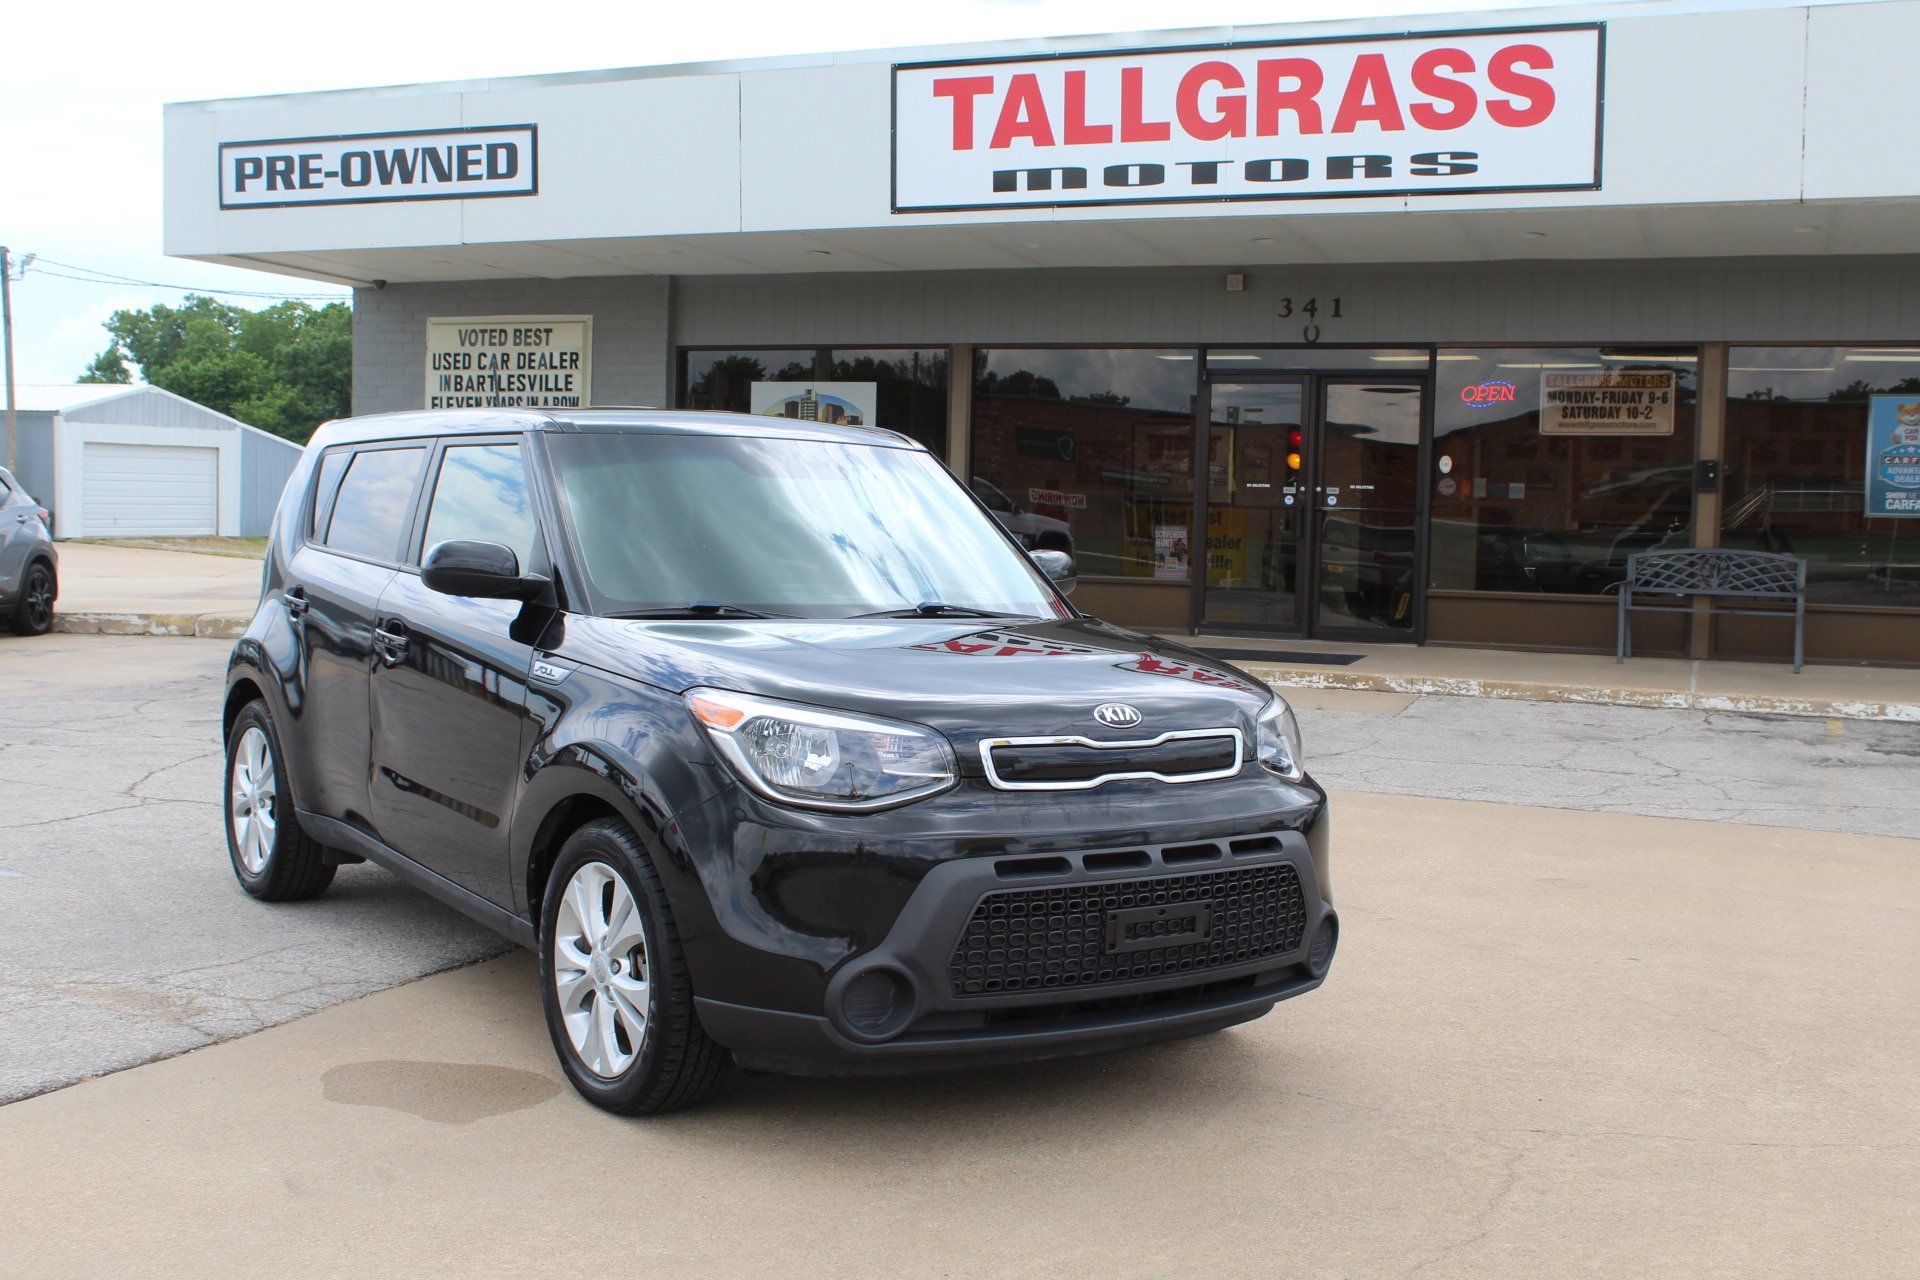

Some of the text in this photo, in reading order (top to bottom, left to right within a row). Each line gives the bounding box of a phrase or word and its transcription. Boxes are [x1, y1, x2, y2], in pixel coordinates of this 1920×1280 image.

[933, 44, 1557, 152] TALLGRASS
[234, 142, 519, 193] PRE-OWNED
[1277, 297, 1343, 319] 341
[458, 328, 553, 347] VOTED BEST
[432, 351, 580, 371] USED CAR DEALER
[439, 374, 573, 392] IN BARTLESVILLE
[1461, 385, 1517, 402] OPEN
[1547, 391, 1669, 404] MONDAY-FRIDAY 9-6
[1561, 405, 1653, 420] SATURDAY 10-2
[1884, 456, 1919, 464] CARF
[1895, 475, 1920, 483] DEALE
[1885, 499, 1920, 510] CARFA
[1101, 706, 1138, 722] KIA
